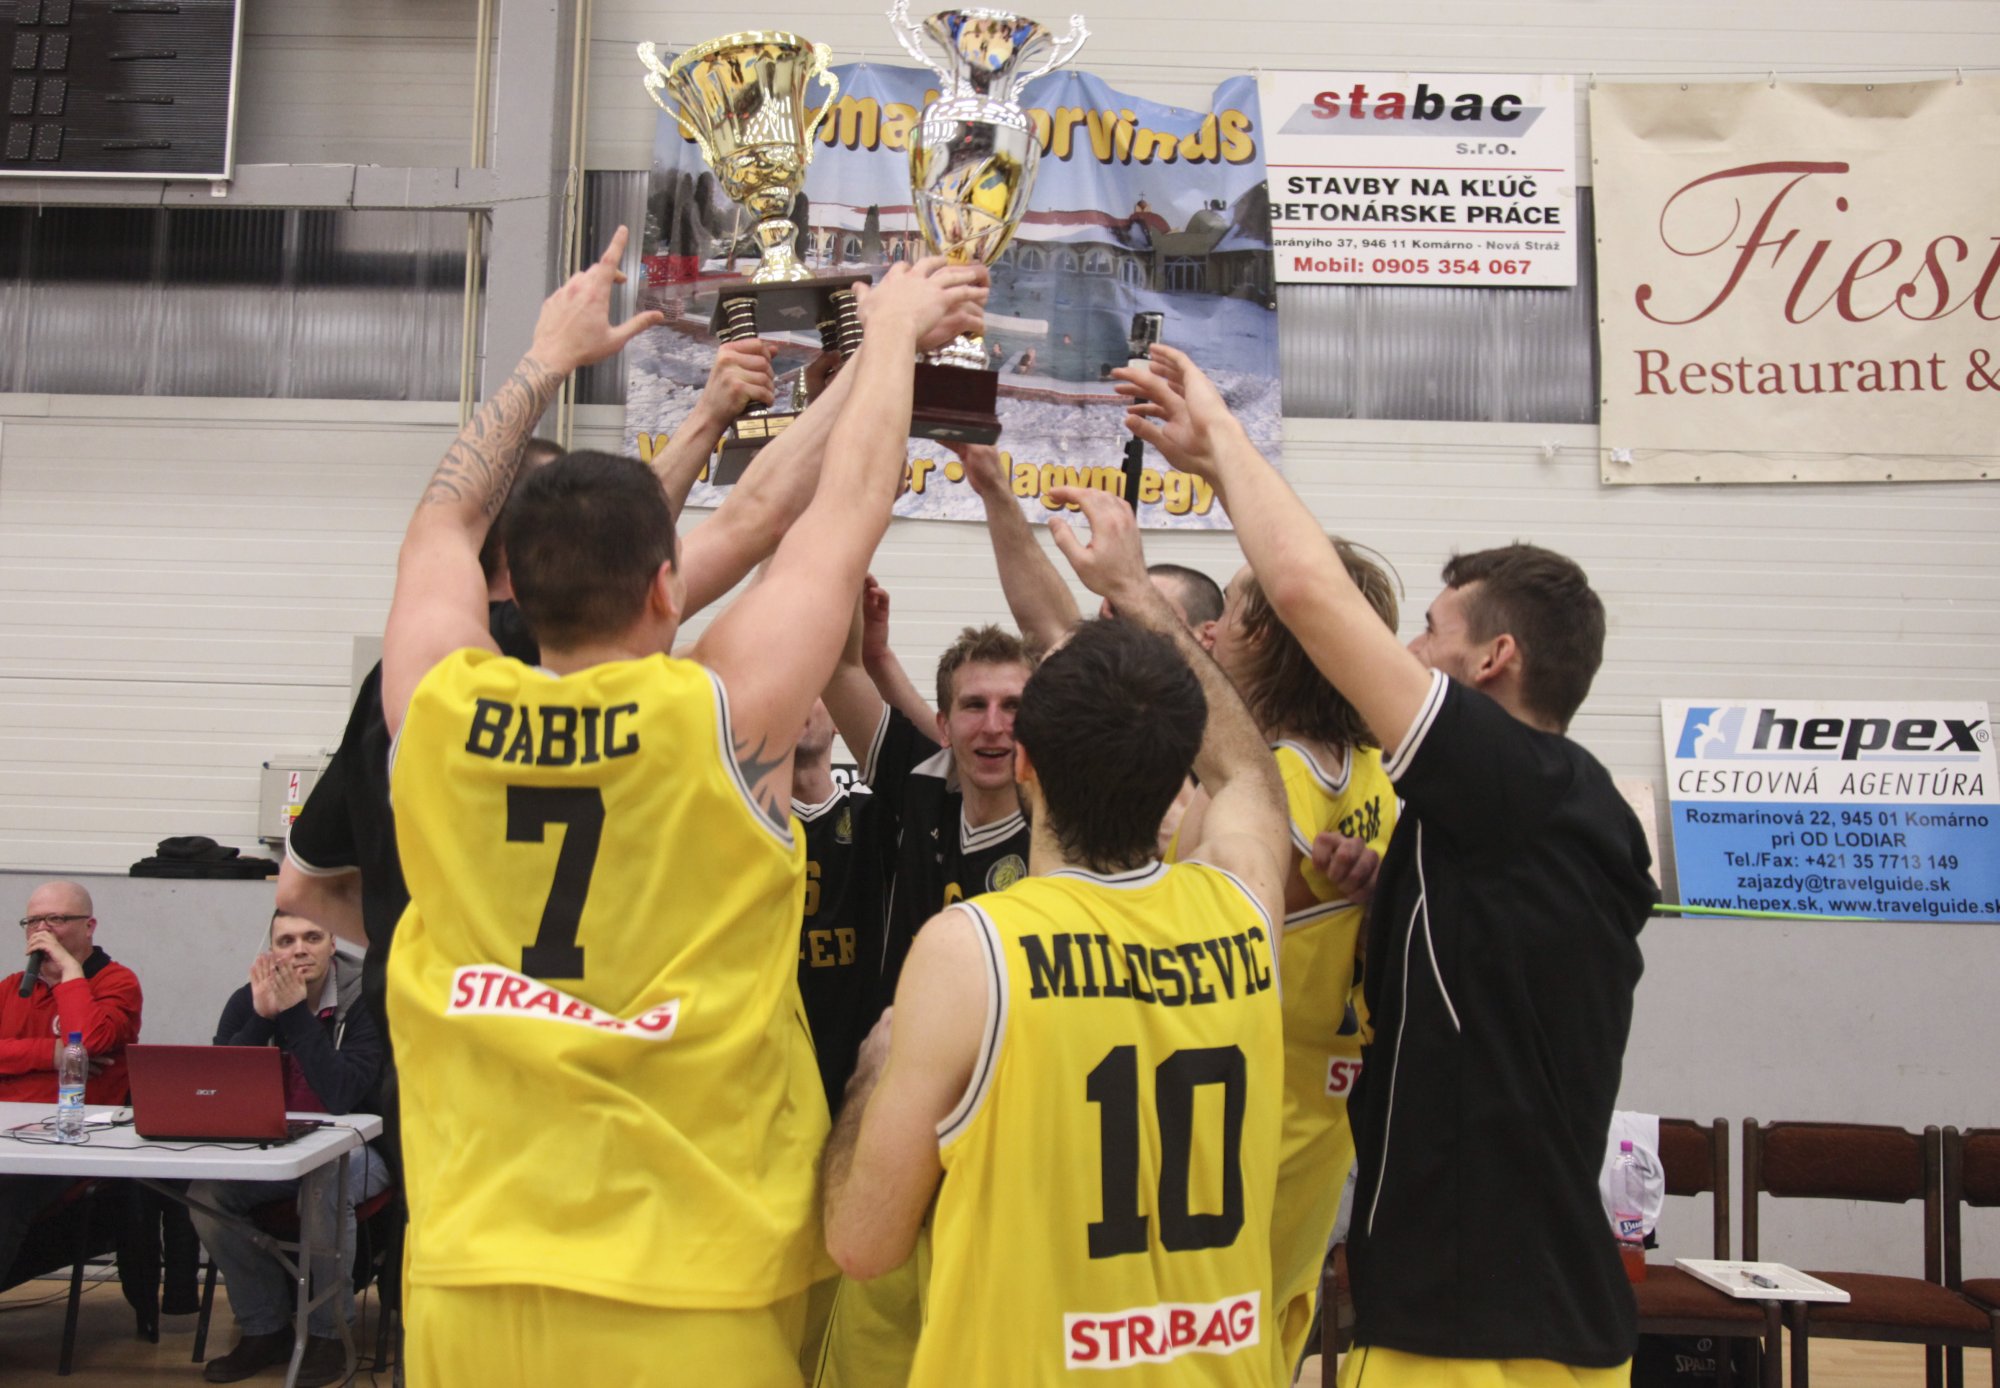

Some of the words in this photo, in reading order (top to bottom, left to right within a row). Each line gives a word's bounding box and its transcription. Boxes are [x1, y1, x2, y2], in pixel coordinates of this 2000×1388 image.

[1311, 84, 1523, 122] stabac
[1456, 143, 1517, 155] s.r.o.
[1288, 177, 1400, 196] STAVBY
[1411, 179, 1450, 196] NA
[1461, 176, 1537, 198] KĽÚČ
[1270, 200, 1456, 223] BETONÁRSKE
[1467, 203, 1560, 224] PRÁCE
[1274, 237, 1332, 248] arányiho
[1337, 239, 1357, 249] 37,
[1362, 239, 1387, 248] 946
[1392, 240, 1406, 248] 11
[1412, 238, 1473, 250] Komárno
[1486, 240, 1520, 250] Nová
[1525, 240, 1560, 251] Stráž
[1293, 257, 1364, 273] Mobil:
[1372, 258, 1429, 274] 0905
[1438, 259, 1480, 275] 354
[1488, 260, 1532, 275] 067
[1633, 349, 1947, 396] Restaurant
[1966, 348, 2000, 392] &
[464, 697, 640, 766] BABIC
[1752, 708, 1985, 761] hepex
[1678, 766, 1819, 795] CESTOVNÁ
[1840, 768, 1985, 796] AGENTÚRA
[1686, 808, 1804, 826] Rozmarínová
[1809, 811, 1836, 828] 22,
[1841, 812, 1873, 826] 945
[1878, 812, 1898, 826] 01
[1905, 811, 1989, 828] Komárno
[1771, 832, 1795, 849] pri
[1801, 832, 1828, 847] OD
[1834, 832, 1906, 848] LODIAR
[1724, 852, 1799, 868] Tel./Fax:
[1805, 854, 1846, 869] +421
[1853, 855, 1874, 869] 35
[1927, 855, 1959, 870] 149
[505, 784, 606, 980] 7
[1737, 874, 1951, 894] zajazdy@travelguide.sk
[1018, 926, 1272, 1007] MILOSEVIC
[1085, 1044, 1247, 1260] 10
[1675, 1354, 1736, 1373] SPALD
